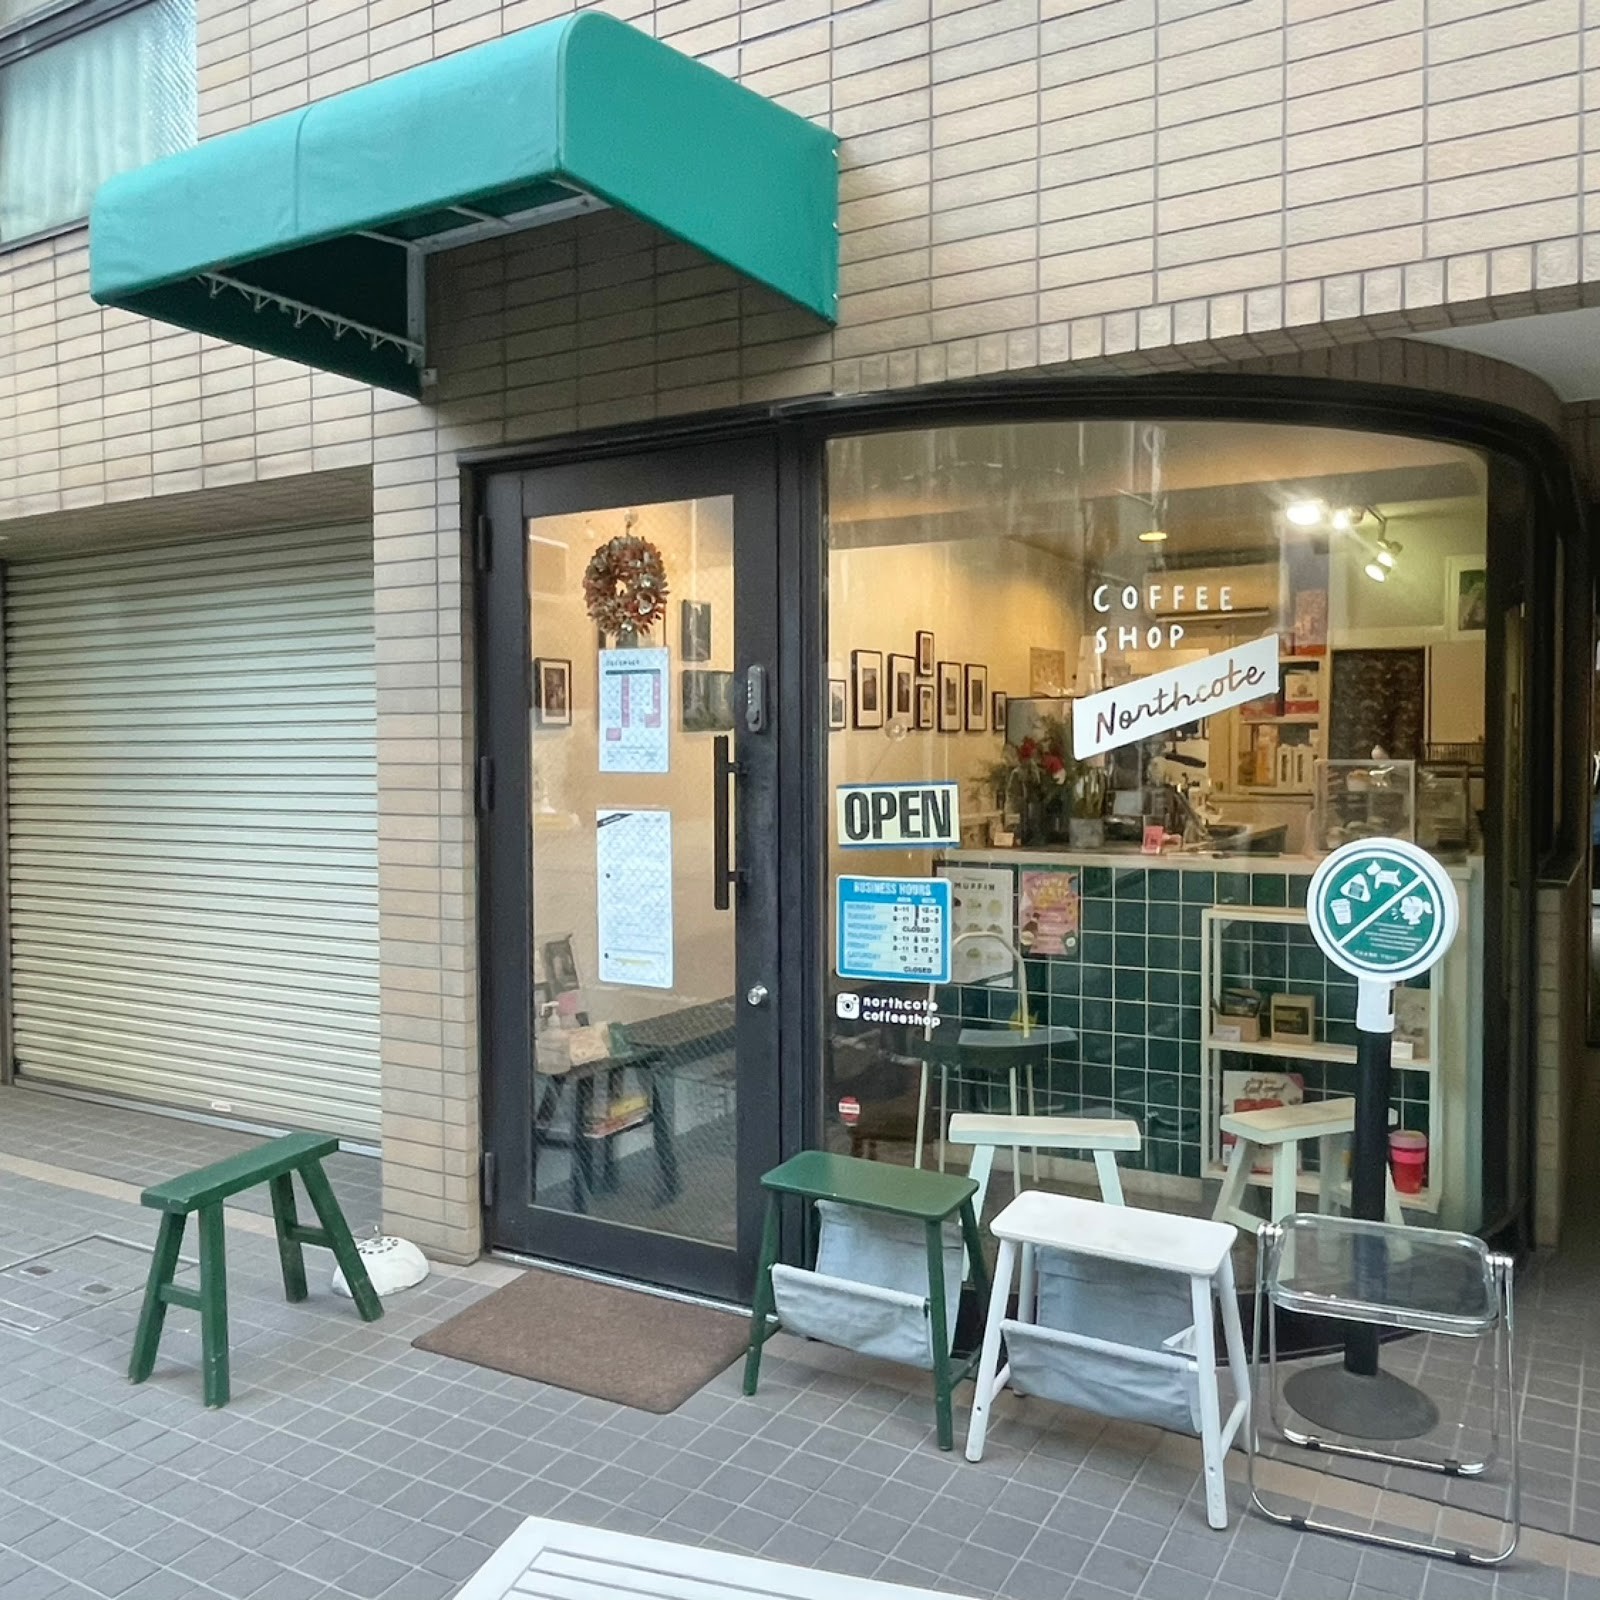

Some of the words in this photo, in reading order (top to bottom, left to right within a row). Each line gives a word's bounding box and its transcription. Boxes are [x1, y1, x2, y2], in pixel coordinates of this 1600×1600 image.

[1093, 584, 1233, 612] COFFEE
[1094, 625, 1184, 654] SHOP
[1096, 658, 1266, 744] Northcote
[844, 789, 951, 841] OPEN
[853, 881, 897, 895] BUSINESS
[899, 883, 932, 897] HOURS
[953, 882, 995, 891] MUFFIN
[862, 996, 938, 1012] northcote
[862, 1011, 941, 1028] coffeeshop
